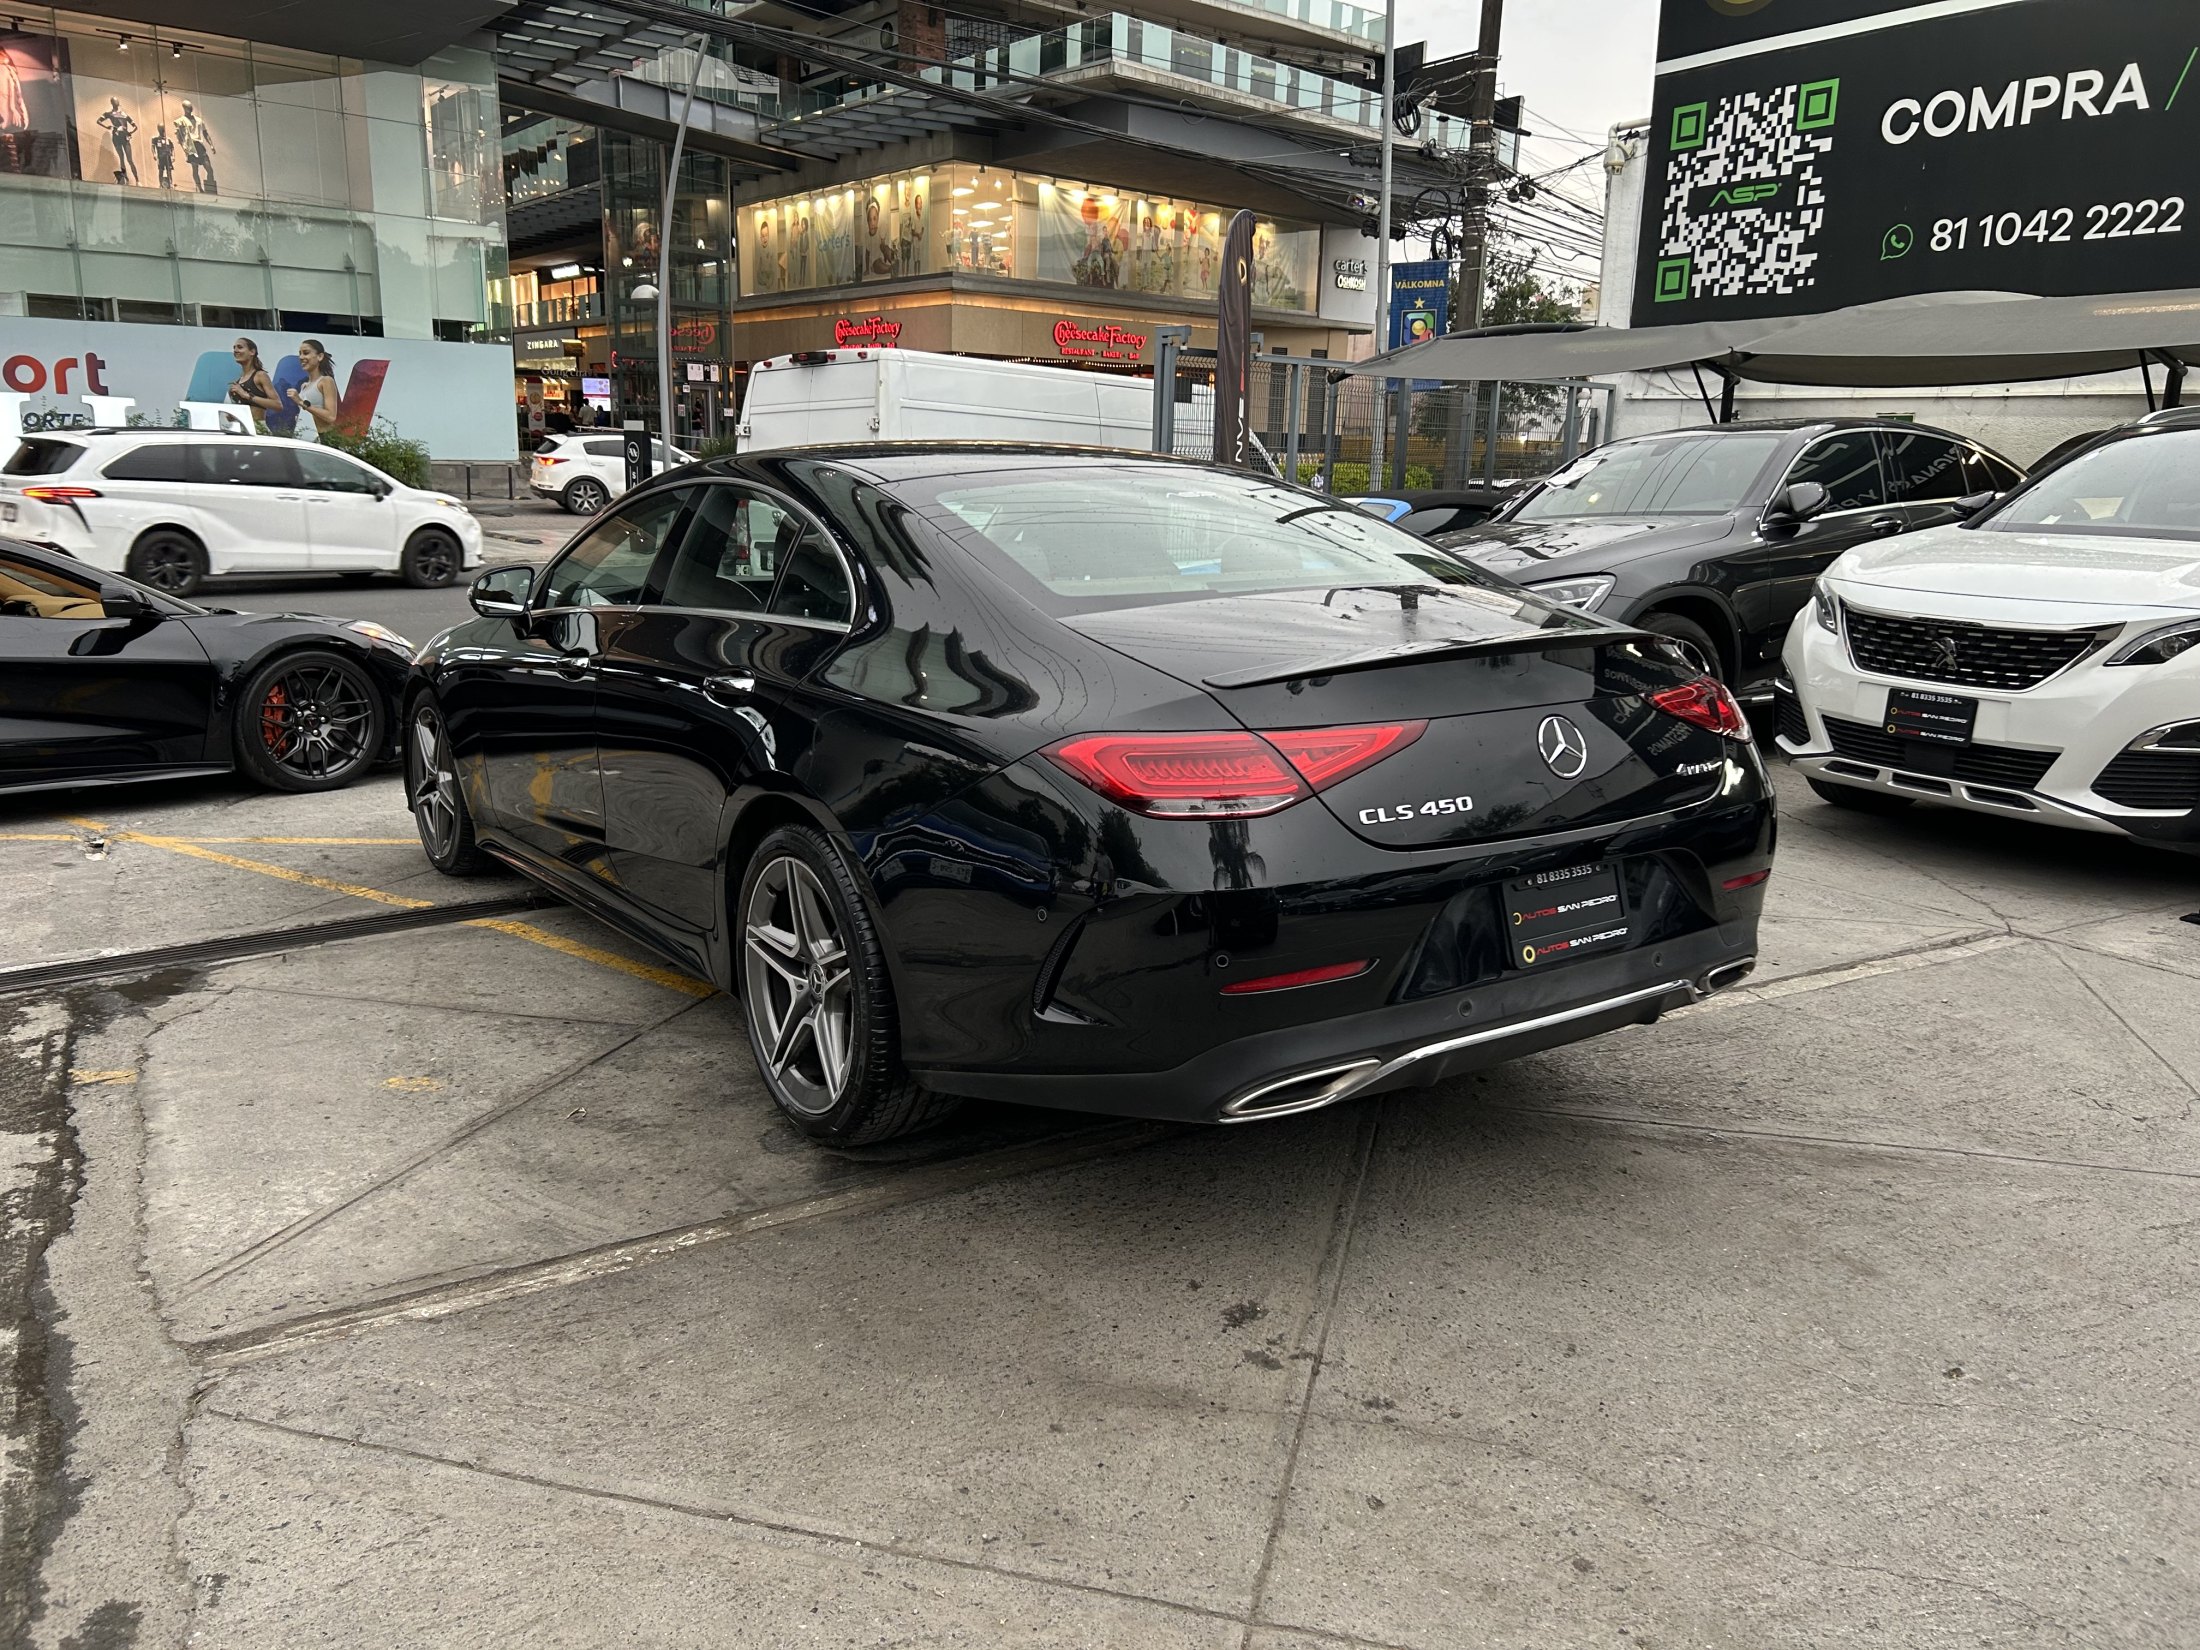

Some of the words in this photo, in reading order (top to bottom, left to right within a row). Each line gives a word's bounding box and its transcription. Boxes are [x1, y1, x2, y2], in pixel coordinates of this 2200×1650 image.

[1881, 62, 2150, 145] COMPRA
[1708, 183, 1779, 208] ASP
[1930, 217, 1969, 252] 81
[1978, 207, 2074, 248] 1042
[2083, 196, 2186, 240] 2222
[1334, 259, 1368, 274] carter's
[1394, 279, 1445, 290] VÄLKOMNA
[836, 318, 872, 344] Cheesecake
[868, 316, 901, 341] Factory
[1054, 320, 1110, 346] Cheesecake
[1105, 325, 1147, 350] Factory
[527, 339, 559, 350] ZINGARA
[541, 366, 569, 378] Gong
[1359, 804, 1414, 825] CLS
[1419, 796, 1473, 816] 450
[1536, 873, 1548, 884] 81
[1548, 869, 1571, 882] 8335
[1571, 864, 1593, 877] 3535
[1522, 907, 1557, 920] AUTOS
[1557, 902, 1580, 913] SAN
[1581, 894, 1618, 908] PEDRO
[1536, 941, 1569, 955] AUTOS
[1569, 936, 1592, 947] SAN
[1592, 927, 1628, 941] PEDRO
